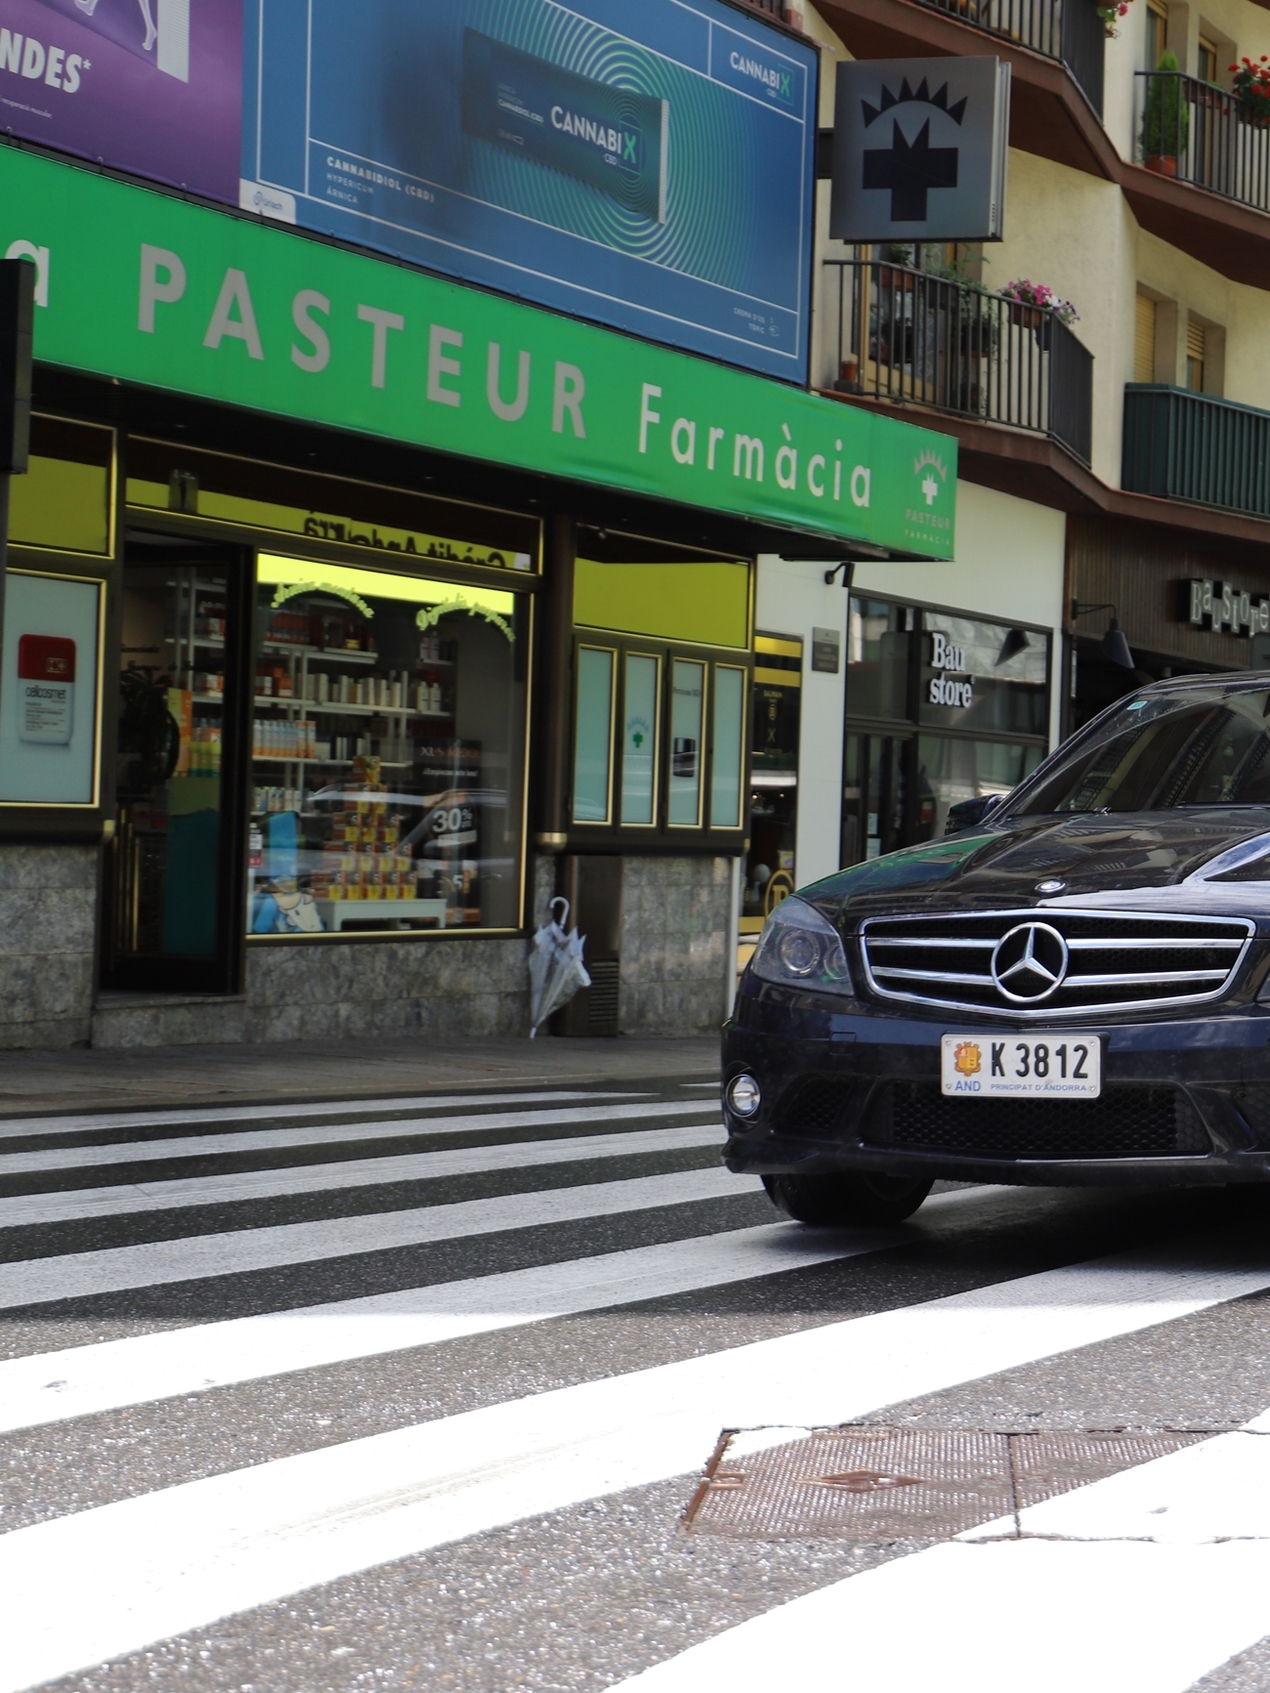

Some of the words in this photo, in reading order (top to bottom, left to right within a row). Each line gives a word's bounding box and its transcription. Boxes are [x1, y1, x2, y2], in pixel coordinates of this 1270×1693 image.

[730, 51, 791, 98] CANNABIX
[551, 105, 637, 164] CANNABIX
[326, 155, 402, 191] CANNABIDIOL
[404, 184, 435, 203] (CBD)
[326, 172, 374, 195] HYPERICUM
[138, 242, 587, 440] PASTEUR
[638, 382, 871, 508] Farmàcia
[904, 508, 951, 530] PASTEUR
[931, 631, 966, 671] Bau
[991, 1042, 1006, 1077] K
[1015, 1043, 1089, 1079] 3812
[954, 1080, 981, 1092] AND
[990, 1083, 1033, 1091] PRINCIPAT
[1035, 1084, 1087, 1092] D'ANDORRA
